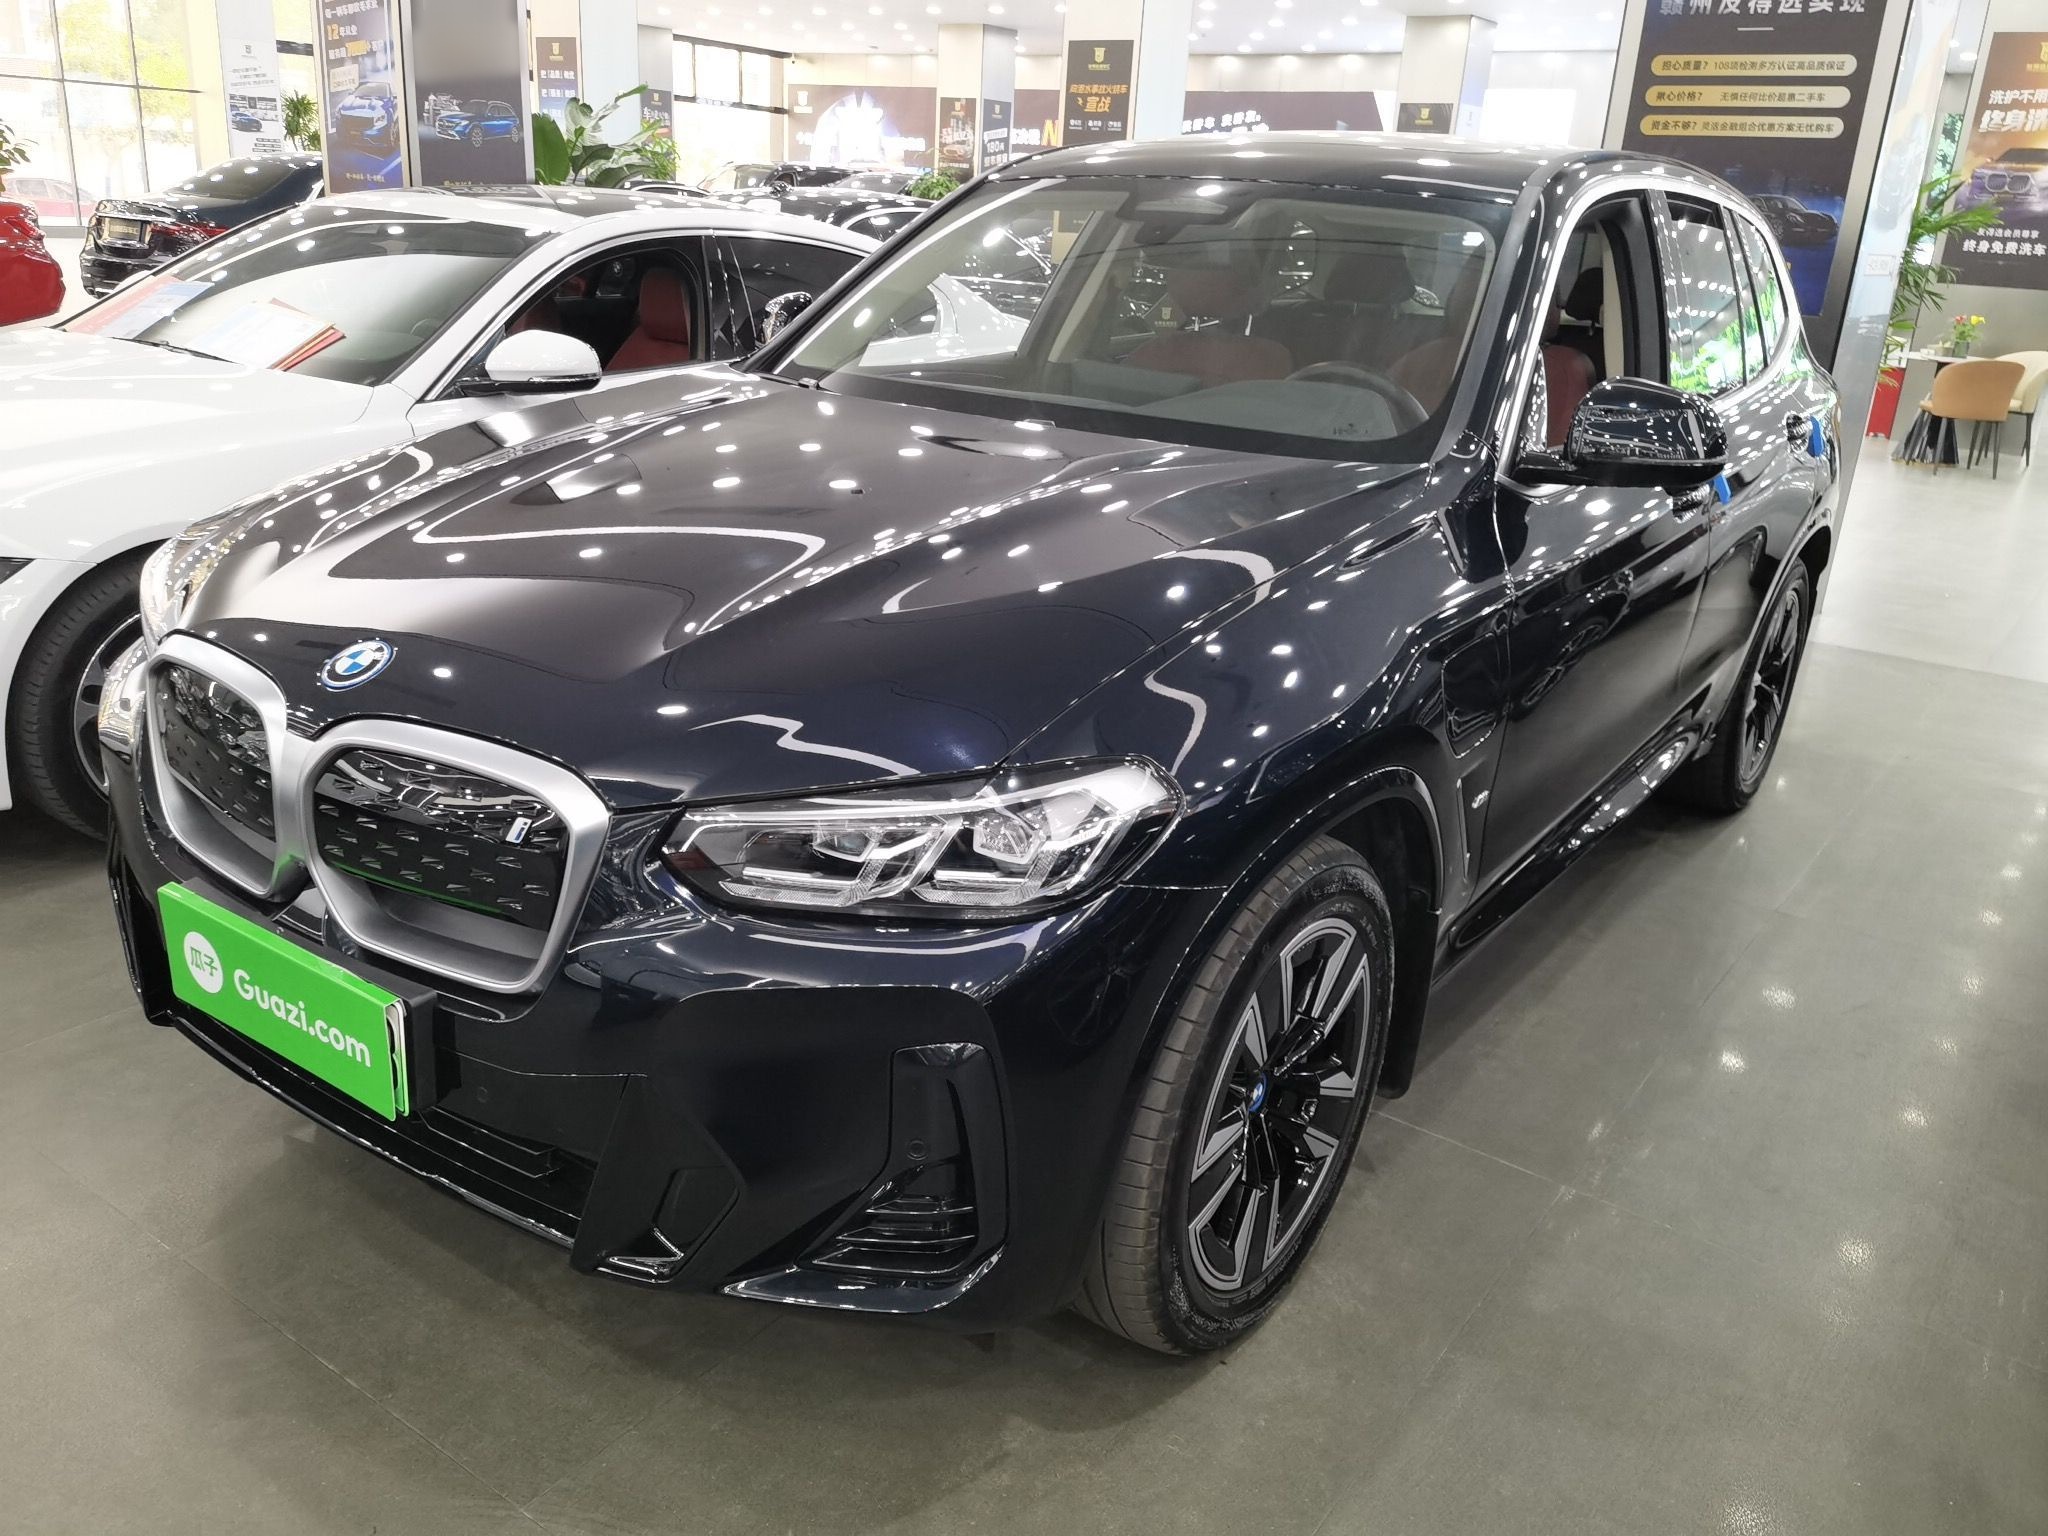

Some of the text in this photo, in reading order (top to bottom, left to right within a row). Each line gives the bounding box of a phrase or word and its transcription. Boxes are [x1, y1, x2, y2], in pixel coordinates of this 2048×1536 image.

[1962, 239, 2047, 256] 终身免费洗车
[189, 945, 219, 977] 瓜子
[233, 968, 372, 1068] Guazi.com
